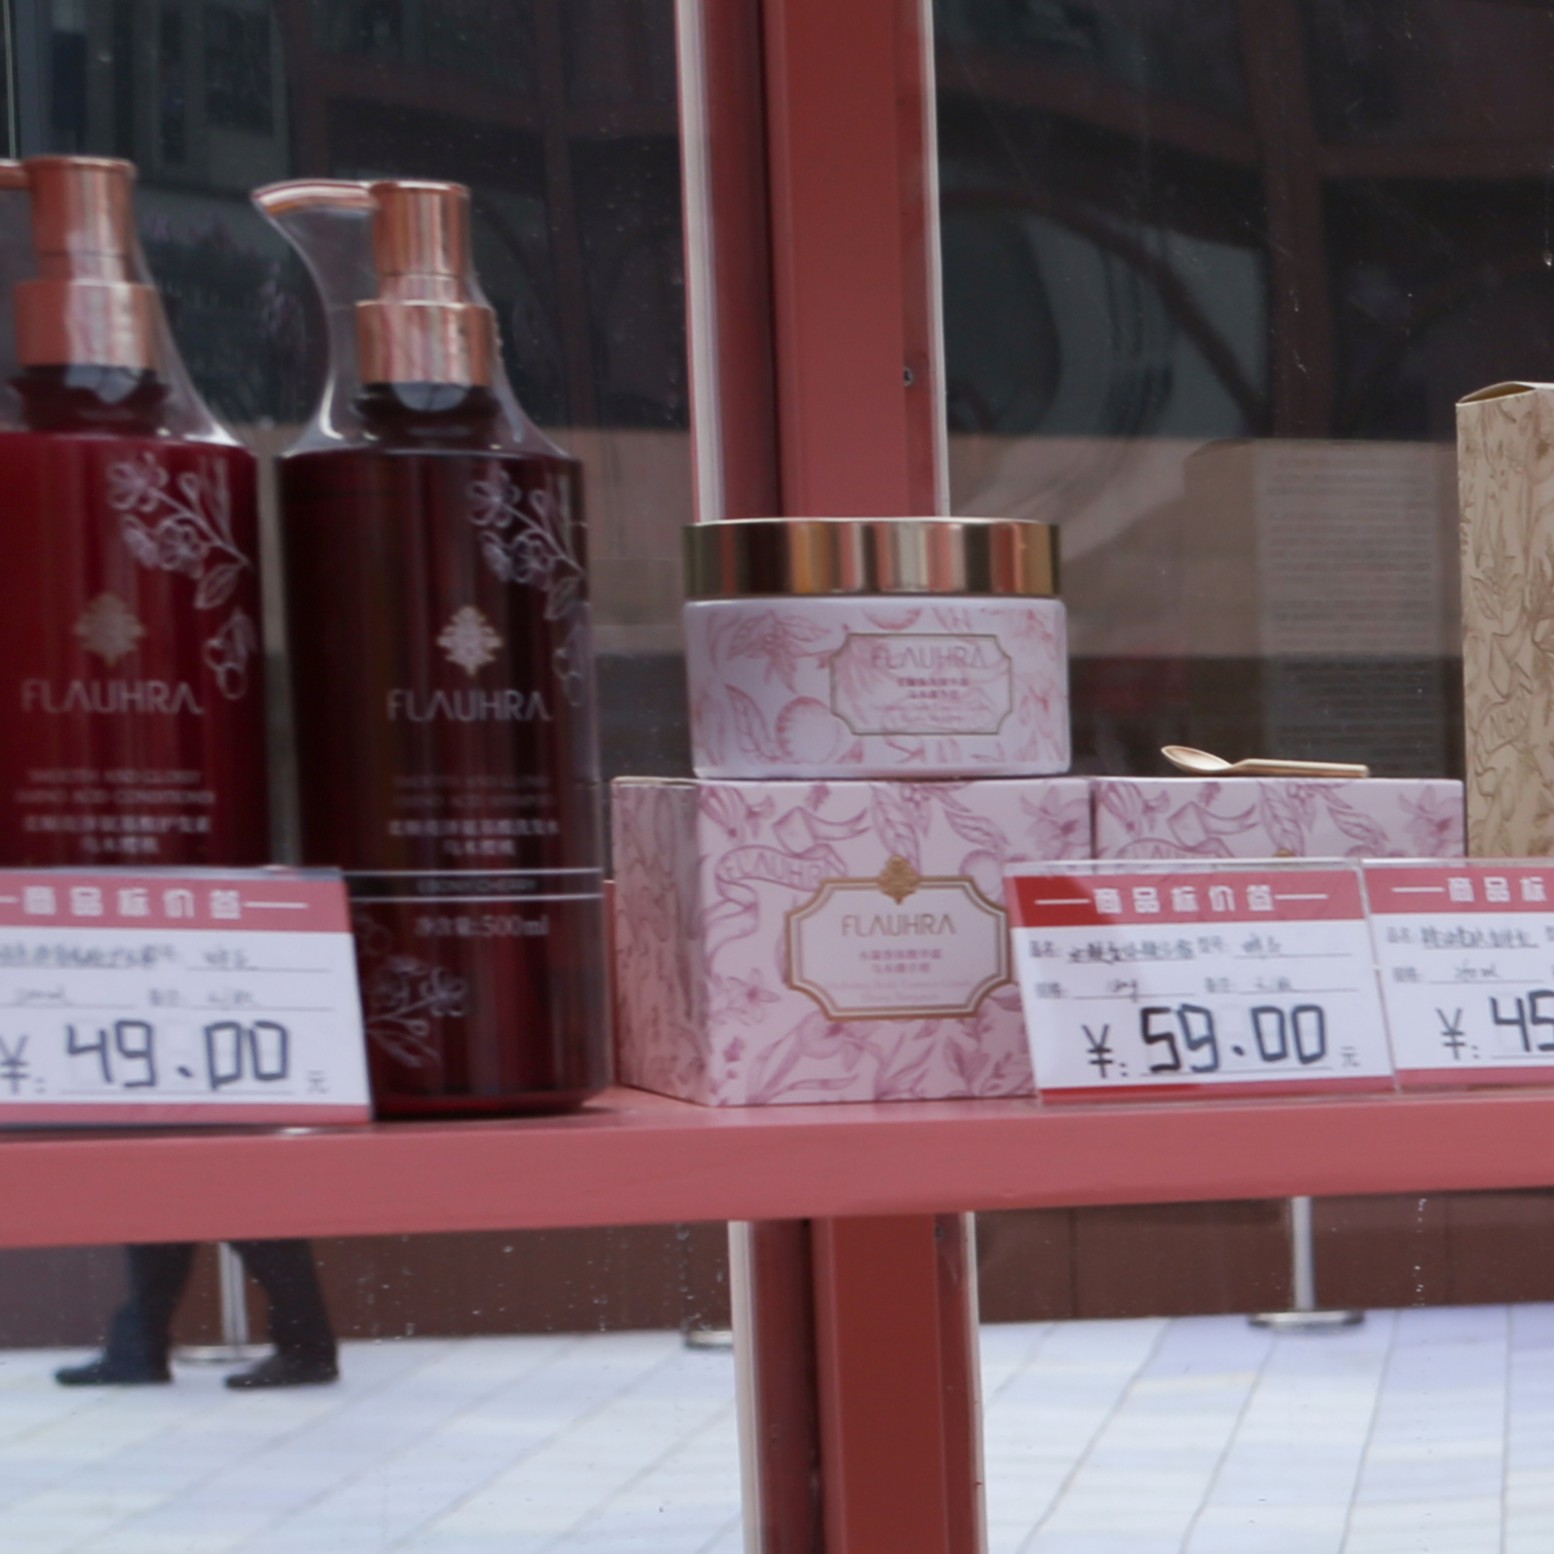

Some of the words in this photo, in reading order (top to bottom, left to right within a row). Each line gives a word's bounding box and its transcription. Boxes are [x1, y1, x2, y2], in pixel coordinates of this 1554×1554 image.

[841, 913, 957, 937] FLAUHRA
[65, 1019, 290, 1091] 49.00
[1140, 1003, 1327, 1073] 59.00
